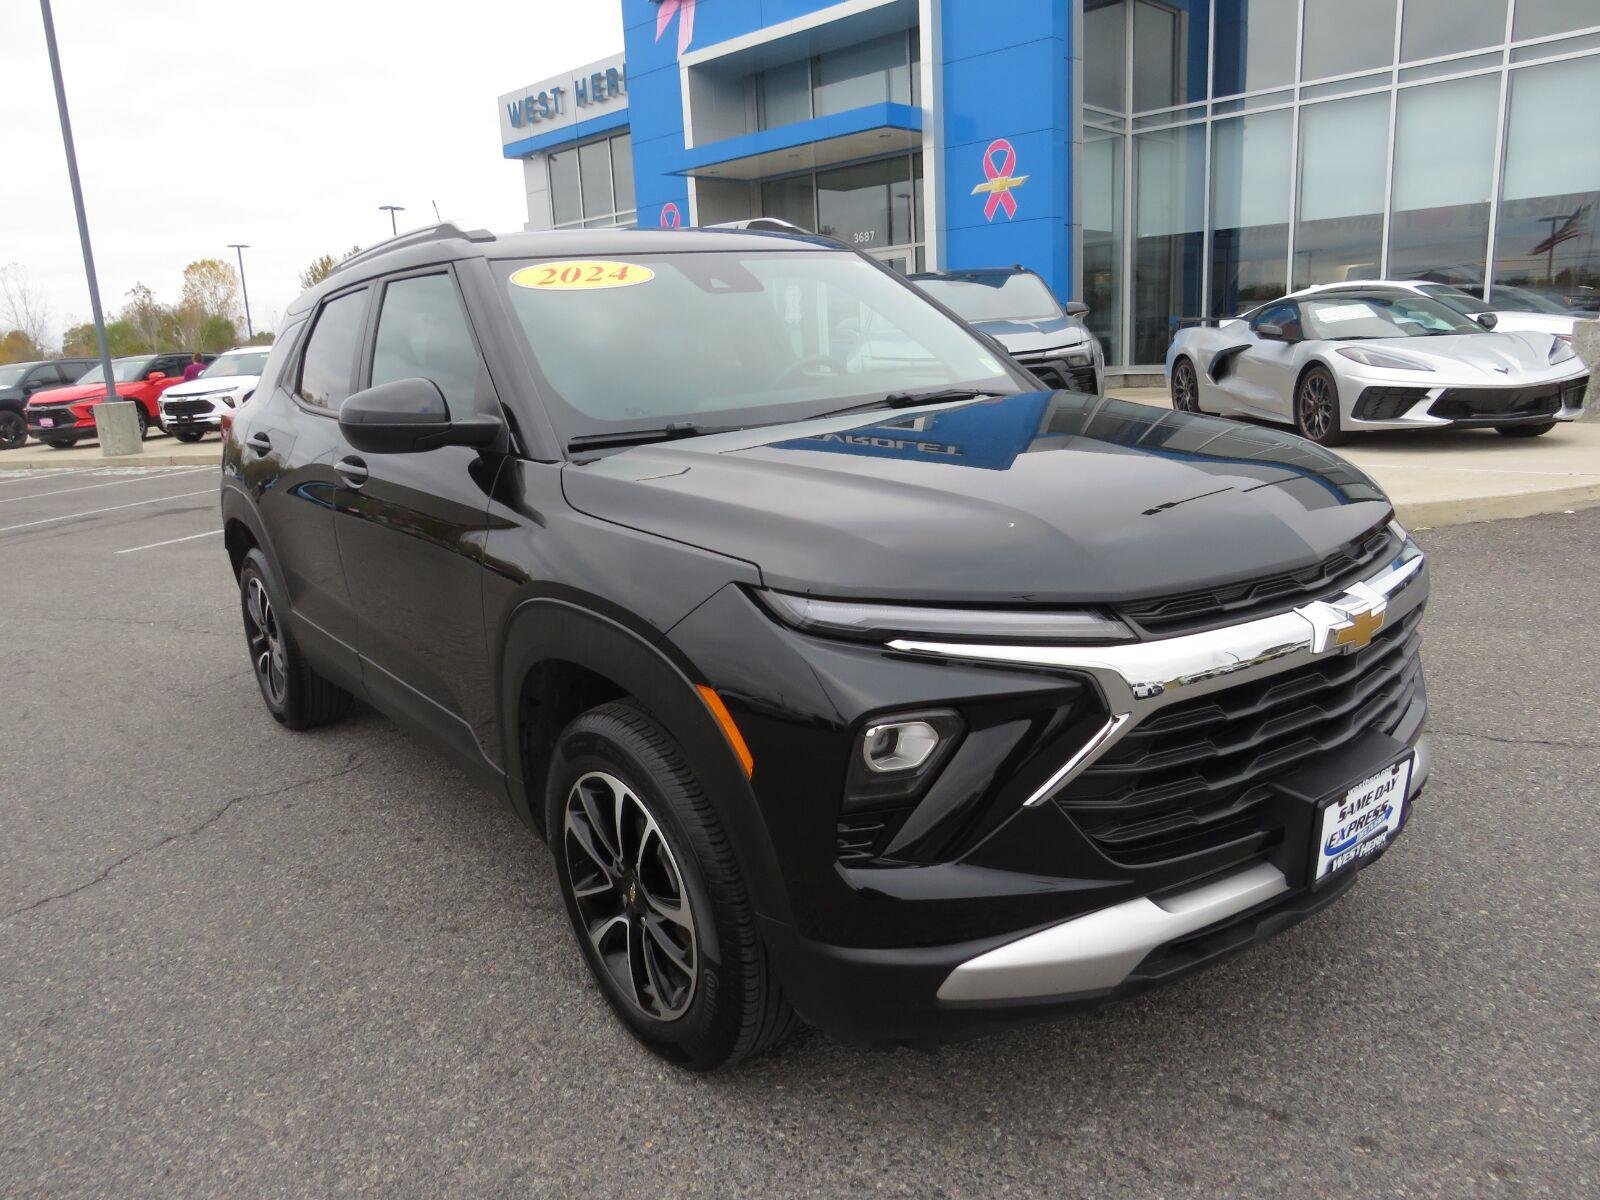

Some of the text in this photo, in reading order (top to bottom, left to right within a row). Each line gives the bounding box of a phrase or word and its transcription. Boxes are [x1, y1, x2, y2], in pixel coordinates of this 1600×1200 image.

[507, 86, 562, 129] WEST
[853, 230, 875, 243] 3687
[537, 266, 629, 286] 2024
[1338, 775, 1400, 824] SAME DAY
[1329, 799, 1390, 848] EXPRESS
